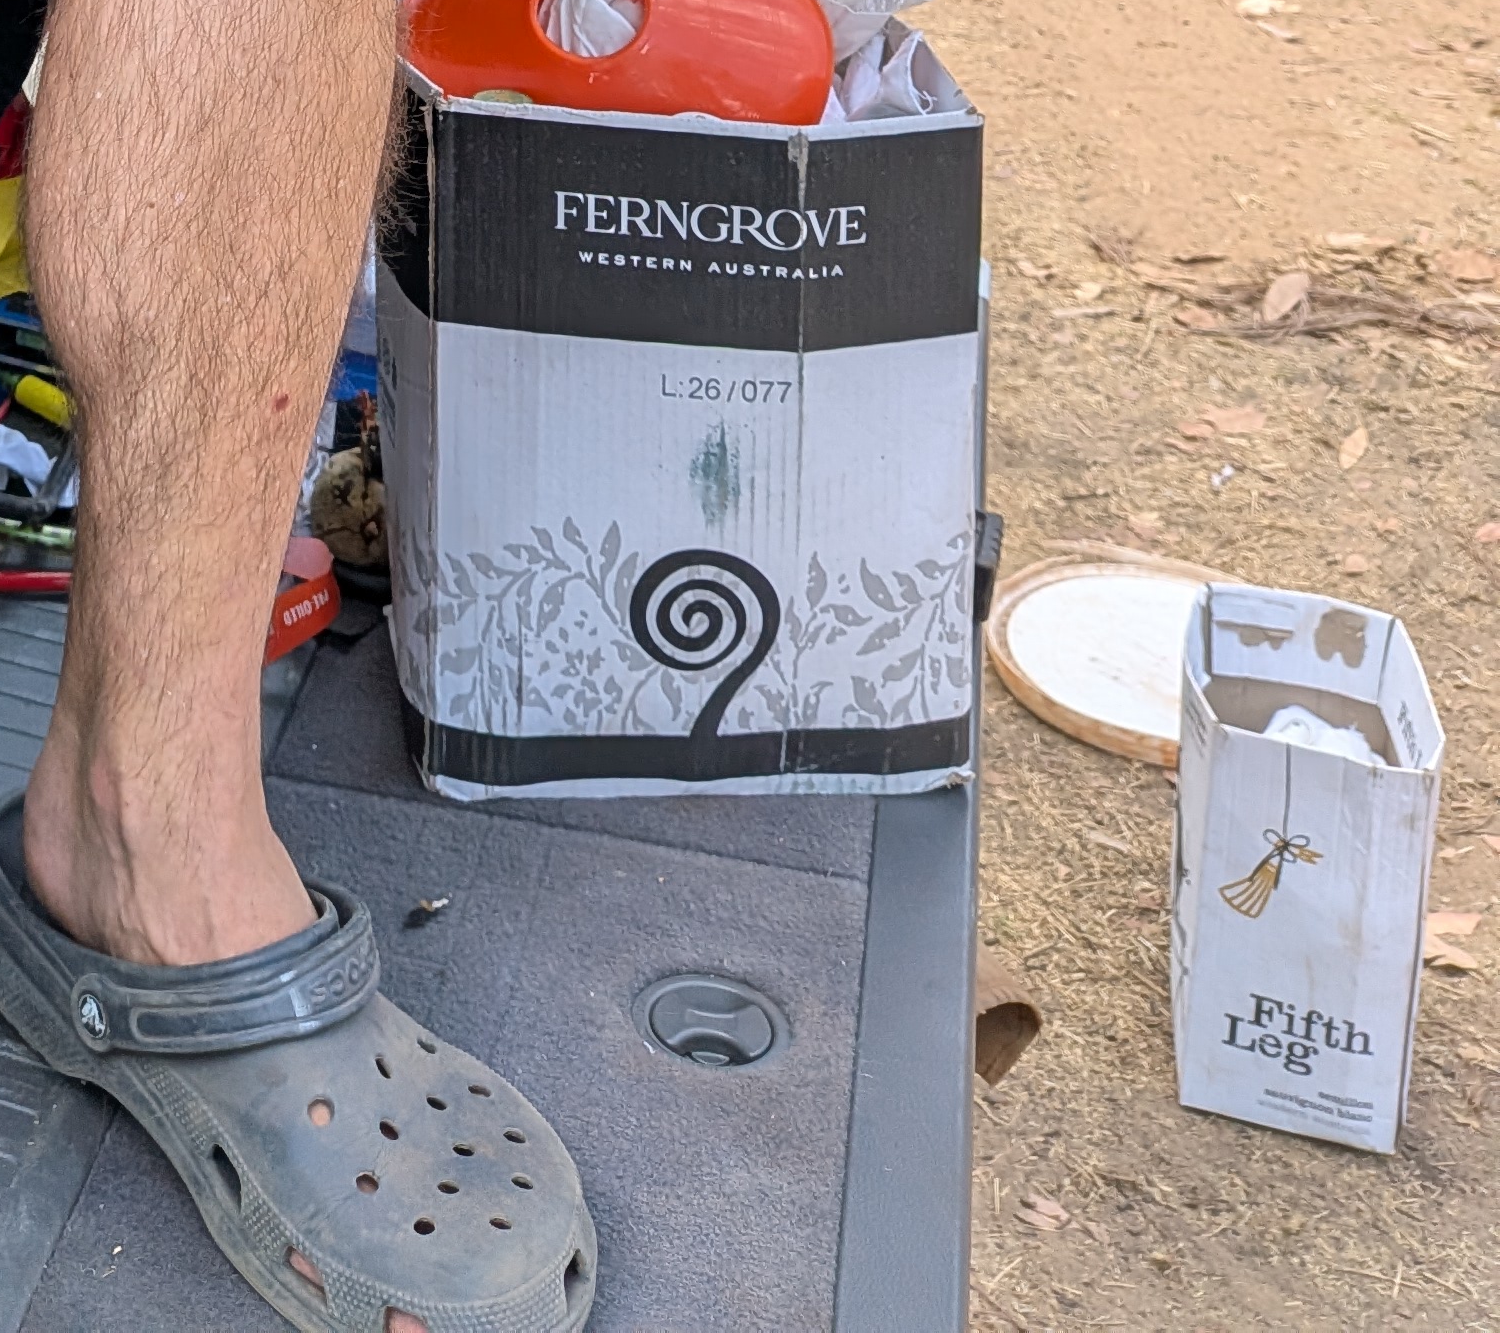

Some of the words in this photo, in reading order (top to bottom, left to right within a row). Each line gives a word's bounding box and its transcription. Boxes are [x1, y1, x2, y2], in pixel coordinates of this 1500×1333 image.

[554, 190, 867, 252] FERNGROVE
[578, 250, 693, 272] WESTERN
[707, 261, 844, 280] AUSTRALIA
[661, 373, 793, 404] L:26/077
[1221, 1012, 1320, 1076] Leg
[1247, 992, 1374, 1056] Fifth
